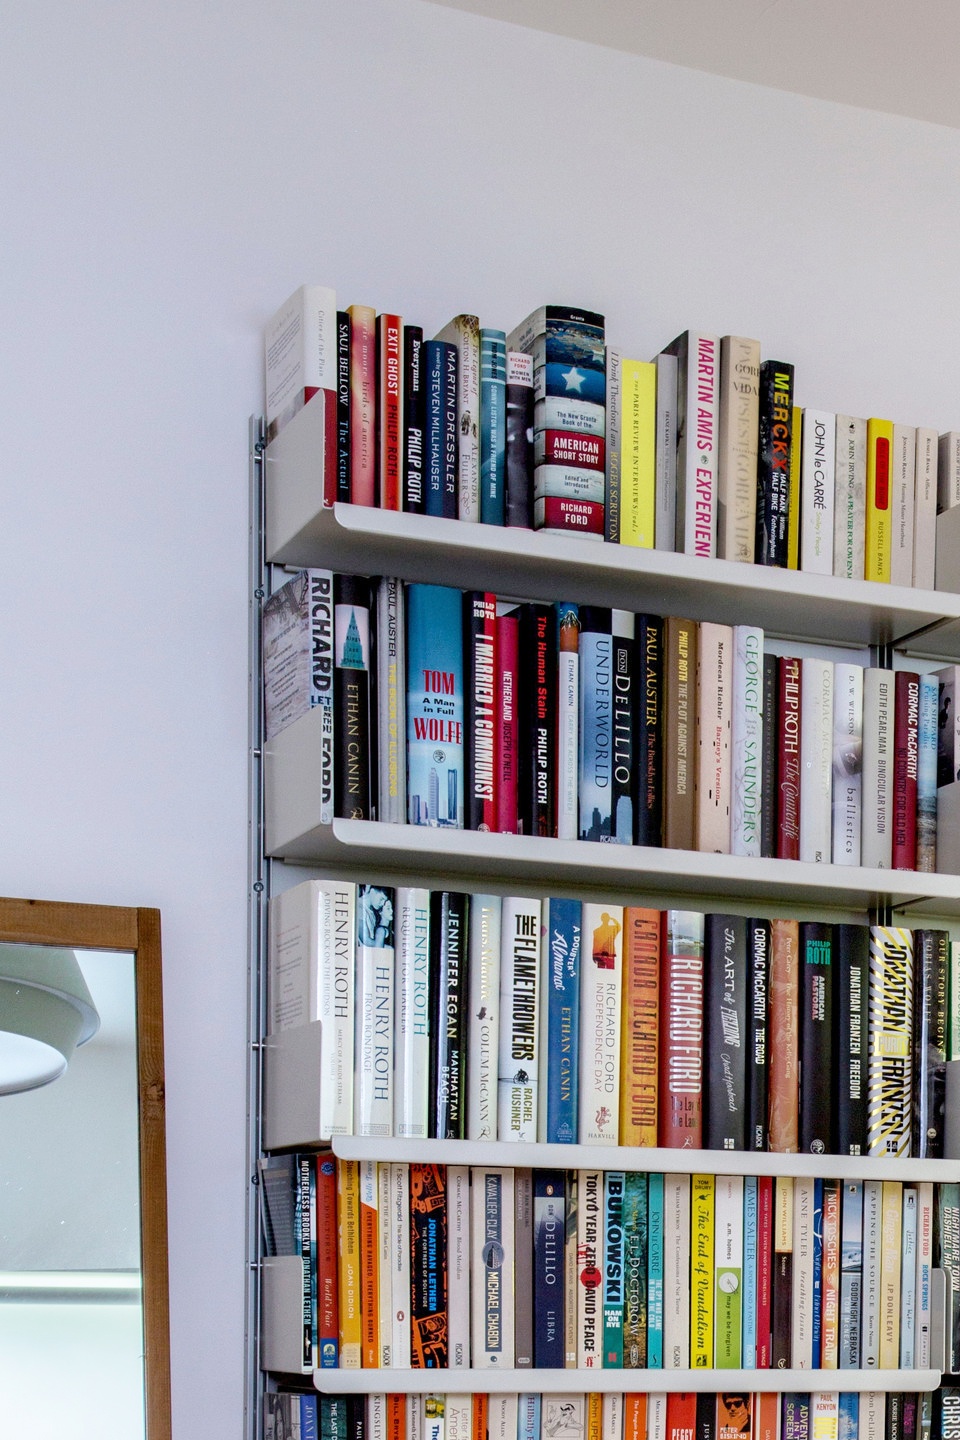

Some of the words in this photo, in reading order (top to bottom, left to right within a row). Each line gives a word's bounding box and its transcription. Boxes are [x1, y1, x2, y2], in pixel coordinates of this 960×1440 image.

[339, 324, 348, 353] SAUL
[387, 328, 397, 354] EXIT
[339, 357, 348, 406] BELLOW
[387, 358, 397, 396] GHOST
[411, 340, 420, 391] Everyman
[447, 351, 456, 407] MARTIN
[698, 338, 714, 403] MARTIN
[431, 370, 440, 415] STEVEN
[697, 408, 713, 451] AMIS
[772, 373, 790, 470] MERCKX
[814, 420, 825, 456] JOHN
[408, 428, 422, 468] PHILIP
[431, 417, 439, 490] MILLHAUSER
[446, 412, 455, 493] DRESSLER
[553, 437, 599, 455] AMERICAN
[553, 449, 577, 463] SHORT
[579, 451, 599, 466] STORY
[814, 458, 825, 468] le
[407, 471, 421, 503] ROTH
[814, 470, 826, 509] CARRÉ
[559, 502, 594, 516] RICHARD
[564, 512, 588, 526] FORD
[388, 582, 396, 609] PAUL
[311, 576, 331, 692] RICHARD
[388, 614, 396, 657] AUSTER
[538, 616, 547, 638] The
[678, 631, 688, 658] PHILIP
[422, 669, 455, 695] TOM
[475, 643, 493, 703] MARRIED
[538, 642, 547, 683] Human
[678, 660, 688, 681] ROTH
[744, 635, 759, 712] GEORGE
[347, 684, 359, 736] ETHAN
[538, 688, 547, 718] Stain
[678, 683, 687, 698] THE
[678, 700, 687, 721] PLOT
[879, 683, 887, 707] EDITH
[908, 682, 918, 725] CORMAC
[412, 717, 463, 745] WOLFE
[475, 706, 493, 716] A
[594, 640, 609, 788] UNDERWORLD
[538, 728, 547, 767] PHILIP
[678, 723, 687, 756] AGAINST
[878, 710, 887, 754] PEARLMAN
[347, 742, 359, 794] CANIN
[475, 719, 493, 801] COMMUNIST
[907, 728, 918, 780] McCARTHY
[538, 772, 547, 804] ROTH
[677, 758, 687, 794] AMERICA
[743, 741, 758, 843] SAUNDERS
[877, 760, 886, 805] BINOCULAR
[877, 808, 886, 834] VISION
[334, 891, 349, 960] HENRY
[448, 910, 459, 986] JENNIFER
[754, 928, 766, 968] CORMAC
[334, 966, 348, 1018] ROTH
[374, 967, 390, 1038] HENRY
[511, 938, 537, 1061] FLAMETHROWERS
[670, 958, 702, 1041] RICHARD
[754, 970, 766, 1021] McCARTHY
[850, 966, 861, 1011] JONATHAN
[883, 942, 907, 1033] JONATHAN
[446, 995, 458, 1038] EGAN
[561, 1007, 570, 1052] ETHAN
[605, 984, 616, 1047] RICHARD
[755, 1028, 765, 1042] THE
[850, 1014, 861, 1054] FRANZEN
[374, 1046, 389, 1100] ROTH
[605, 1054, 615, 1093] FORD
[669, 1046, 702, 1093] FORD
[755, 1044, 765, 1064] ROAD
[441, 1066, 450, 1103] BEACH
[449, 1050, 459, 1120] MANHATTAN
[560, 1058, 570, 1101] CANIN
[850, 1059, 861, 1099] FREEDOM
[880, 1057, 905, 1135] FRANZEN
[511, 1087, 522, 1131] KUSHNER
[522, 1088, 533, 1124] RACHEL
[301, 1161, 310, 1209] MOTHERLESS
[302, 1212, 310, 1251] BROOKLYN
[697, 1206, 710, 1230] The
[951, 1207, 960, 1261] NIGHTMARE
[428, 1218, 437, 1269] JONATHAN
[607, 1181, 622, 1302] BUKOWSKI
[698, 1233, 709, 1258] End
[695, 1261, 709, 1275] of
[952, 1265, 960, 1291] TOWN
[429, 1273, 437, 1311] LETHEM
[487, 1271, 499, 1311] MICHAEL
[585, 1281, 597, 1315] DAVID
[630, 1257, 640, 1336] DOCTOROW
[487, 1314, 499, 1348] CHABON
[546, 1311, 555, 1342] LIBRA
[697, 1279, 709, 1349] Vandalism
[584, 1318, 595, 1352] PEACE
[786, 1403, 794, 1439] SCREEN
[794, 1422, 800, 1432] IN
